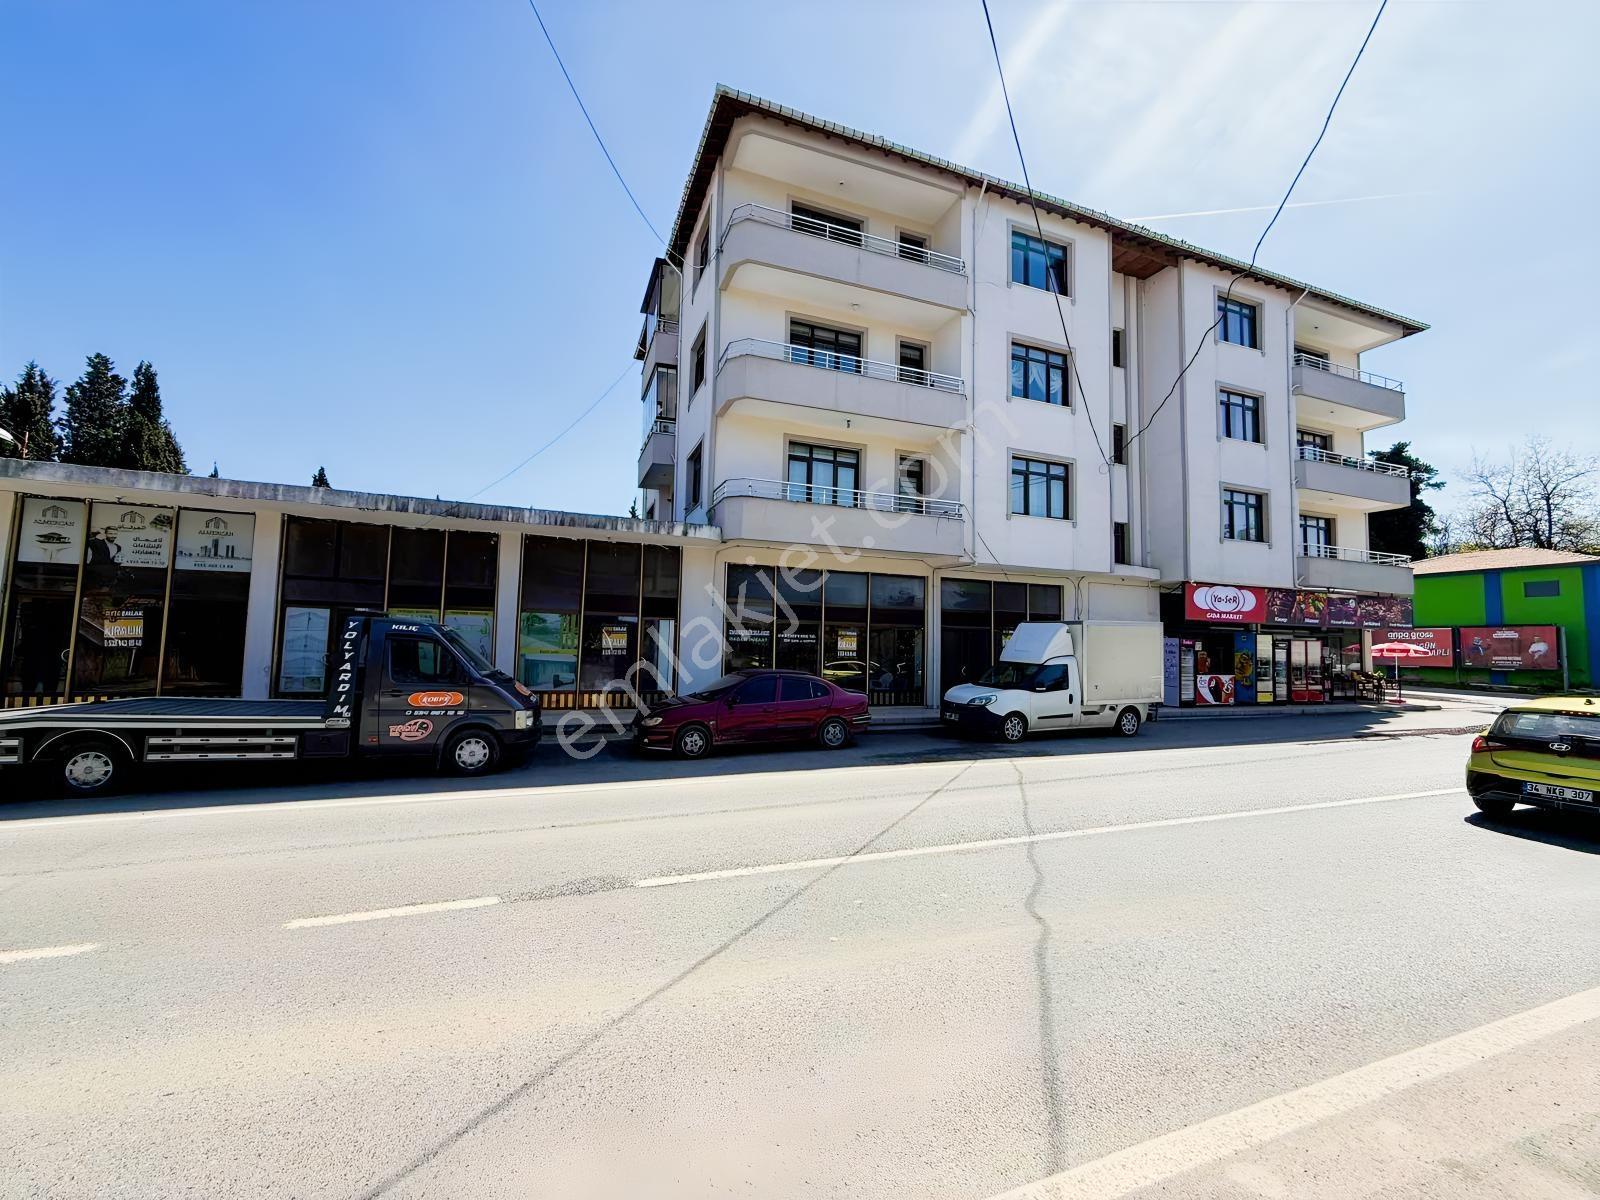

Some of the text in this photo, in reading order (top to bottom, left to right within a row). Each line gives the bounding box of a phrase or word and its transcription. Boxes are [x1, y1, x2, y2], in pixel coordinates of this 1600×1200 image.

[1387, 631, 1409, 640] anpa
[1527, 783, 1540, 792] 34
[1571, 790, 1592, 801] 307
